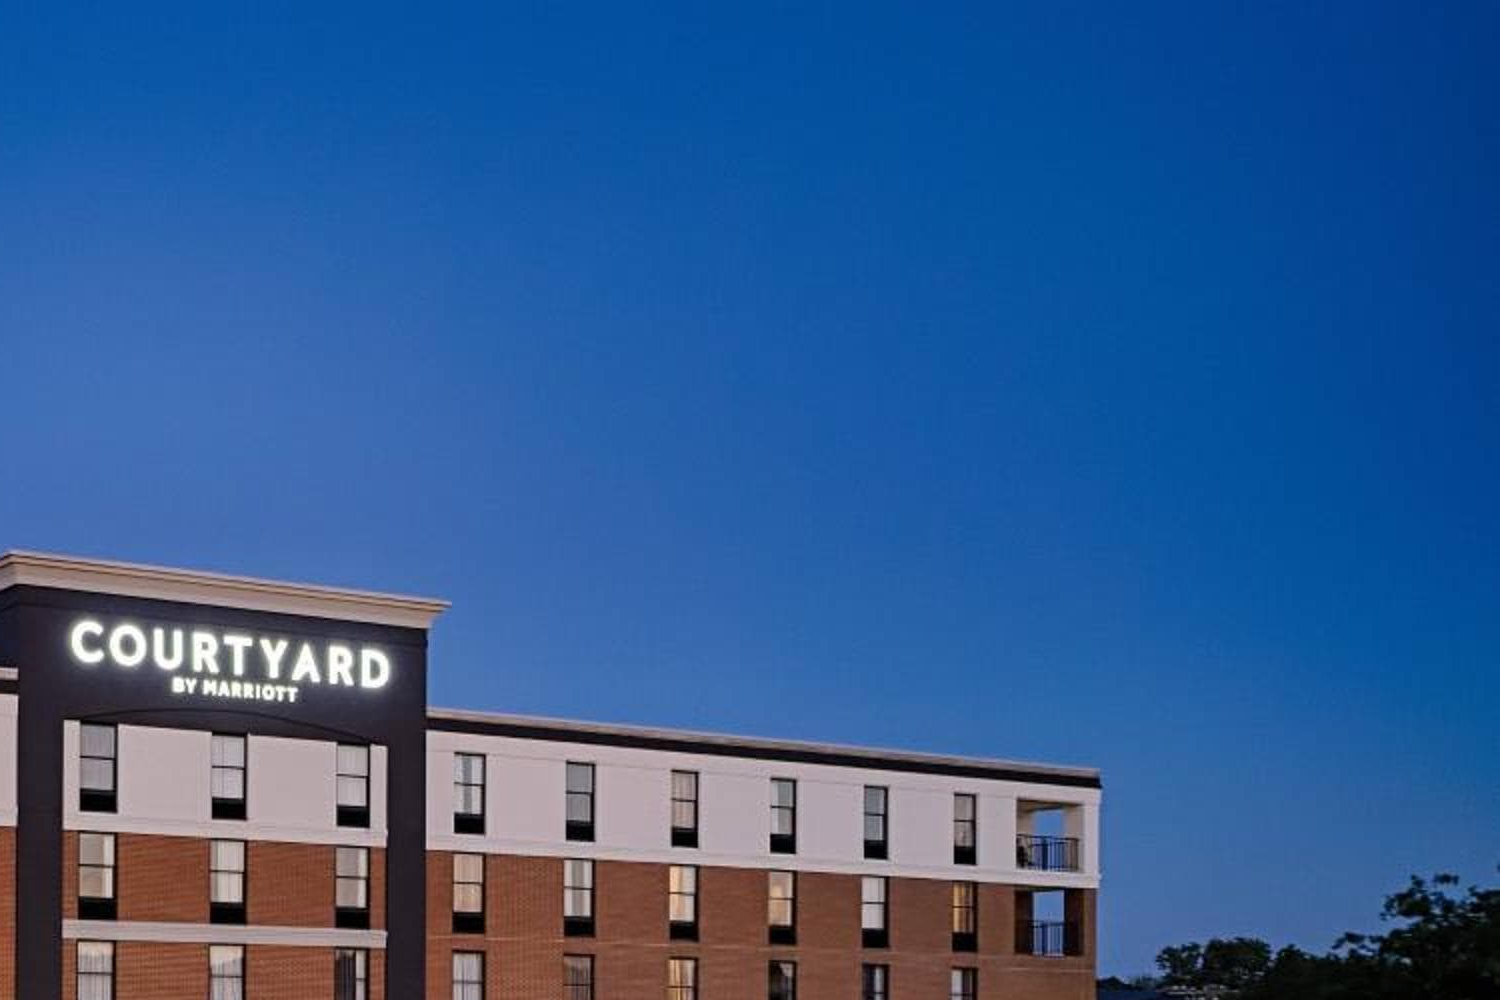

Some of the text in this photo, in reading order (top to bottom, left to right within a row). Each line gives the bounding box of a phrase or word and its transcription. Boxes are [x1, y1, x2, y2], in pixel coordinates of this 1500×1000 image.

[69, 618, 392, 690] COURTYARD
[172, 676, 299, 702] BY MARRIOTT
